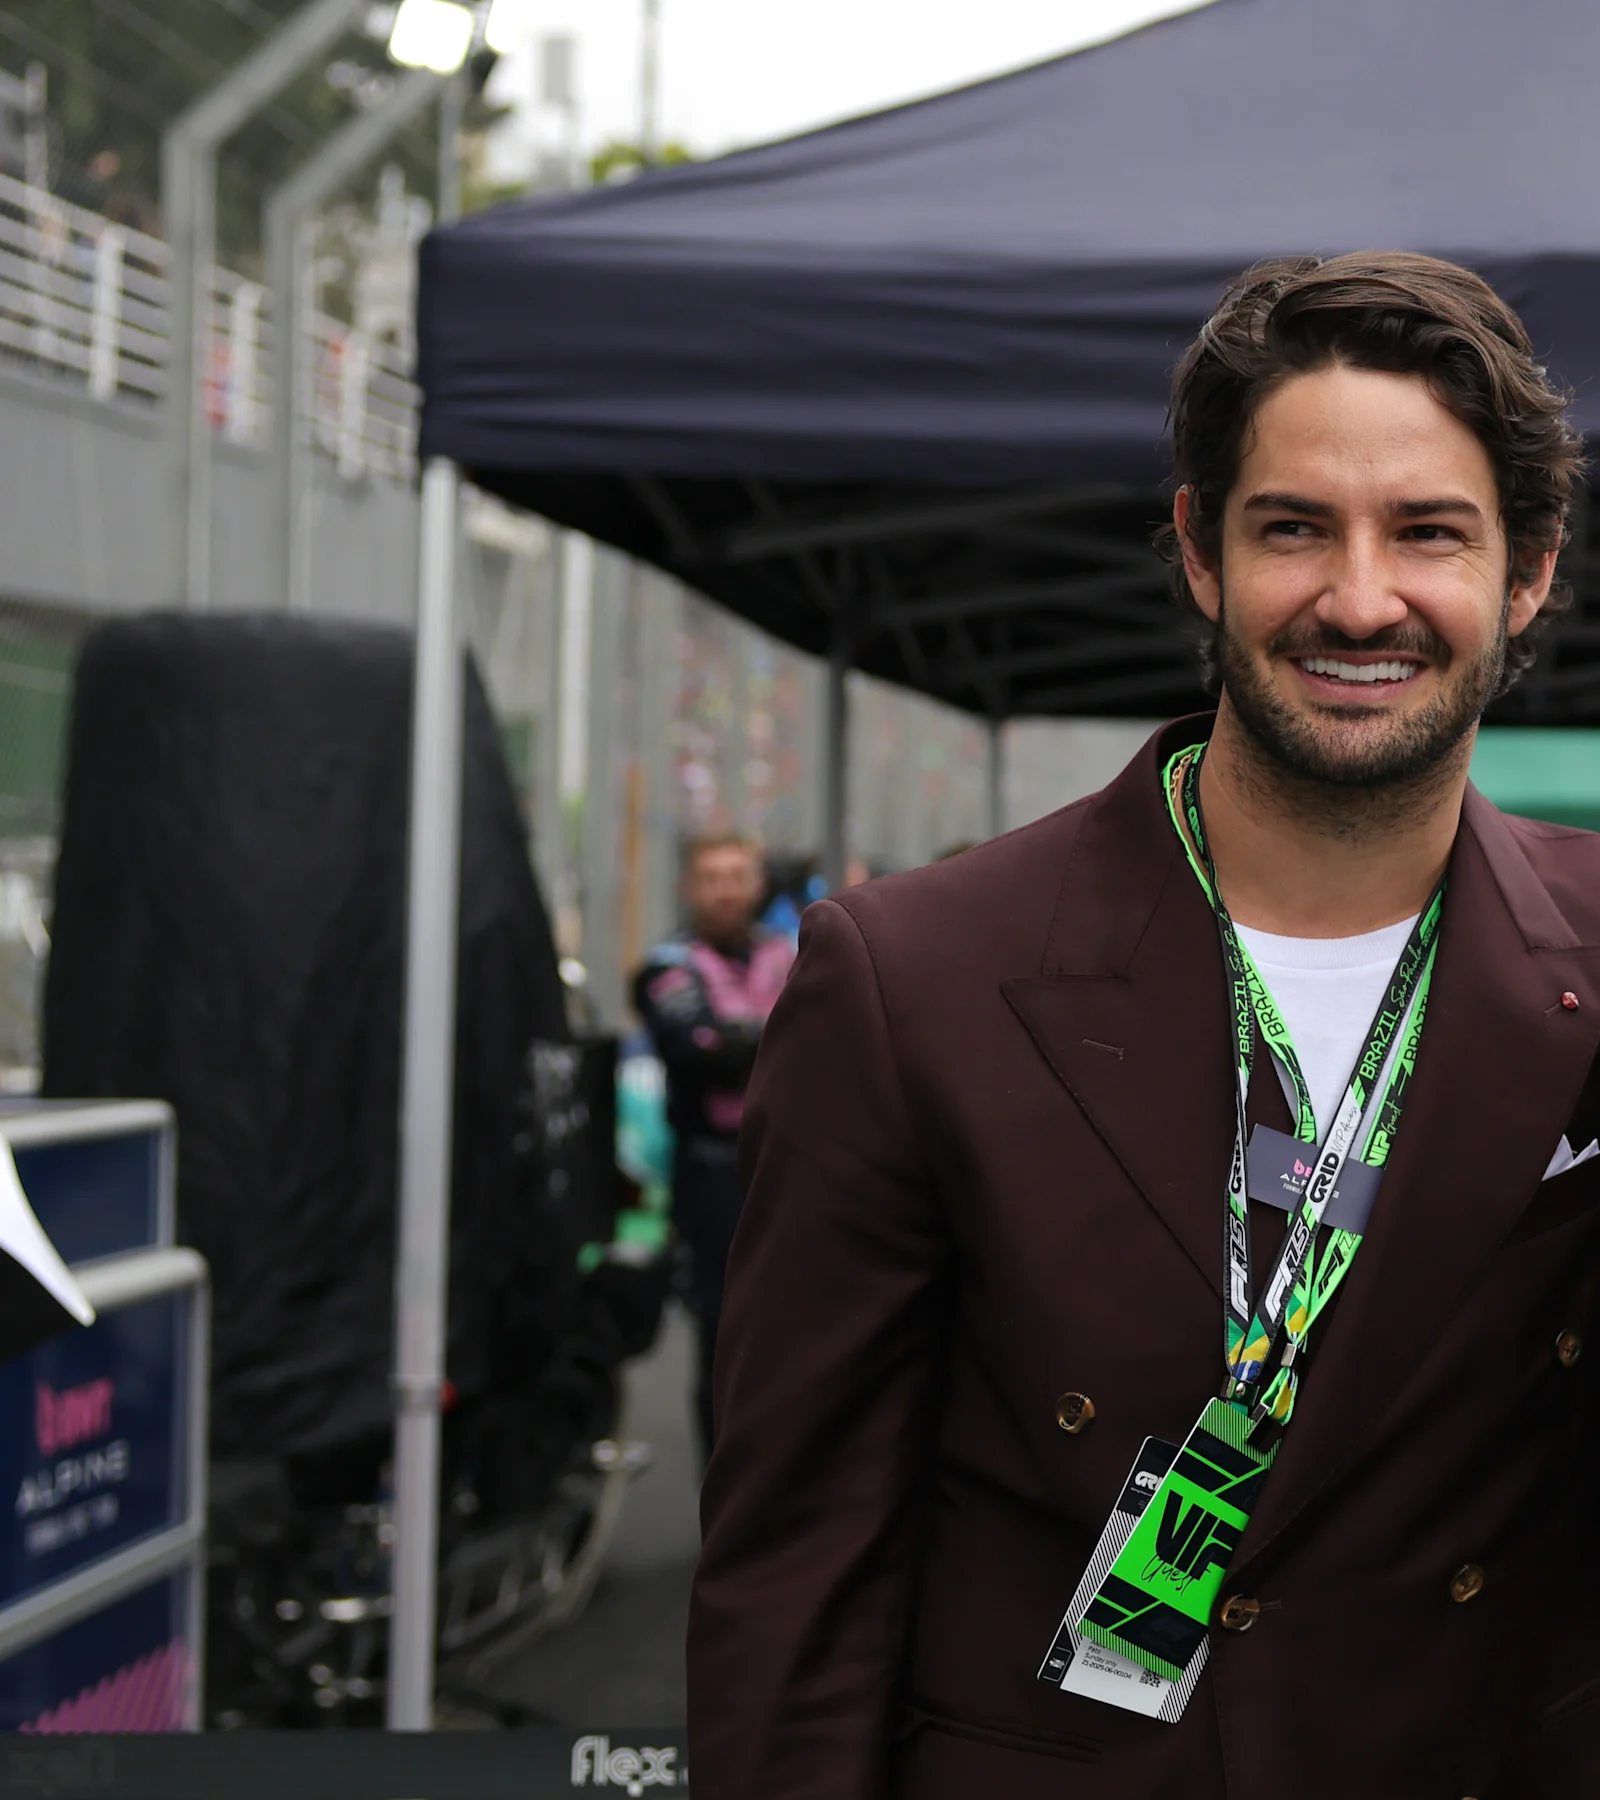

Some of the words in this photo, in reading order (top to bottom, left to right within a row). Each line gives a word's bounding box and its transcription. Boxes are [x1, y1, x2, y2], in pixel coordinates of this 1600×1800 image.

[1233, 974, 1250, 1054] BRAZIL
[1359, 1010, 1400, 1080] BRAZIL
[1400, 944, 1422, 987] Paulo
[1310, 1152, 1340, 1203] GRID
[1331, 1127, 1346, 1155] VIP
[1366, 1130, 1392, 1167] VIP
[1084, 1652, 1106, 1665] Sunday
[1105, 1659, 1118, 1667] only
[1088, 1646, 1101, 1655] Pato
[570, 1735, 678, 1797] flex
